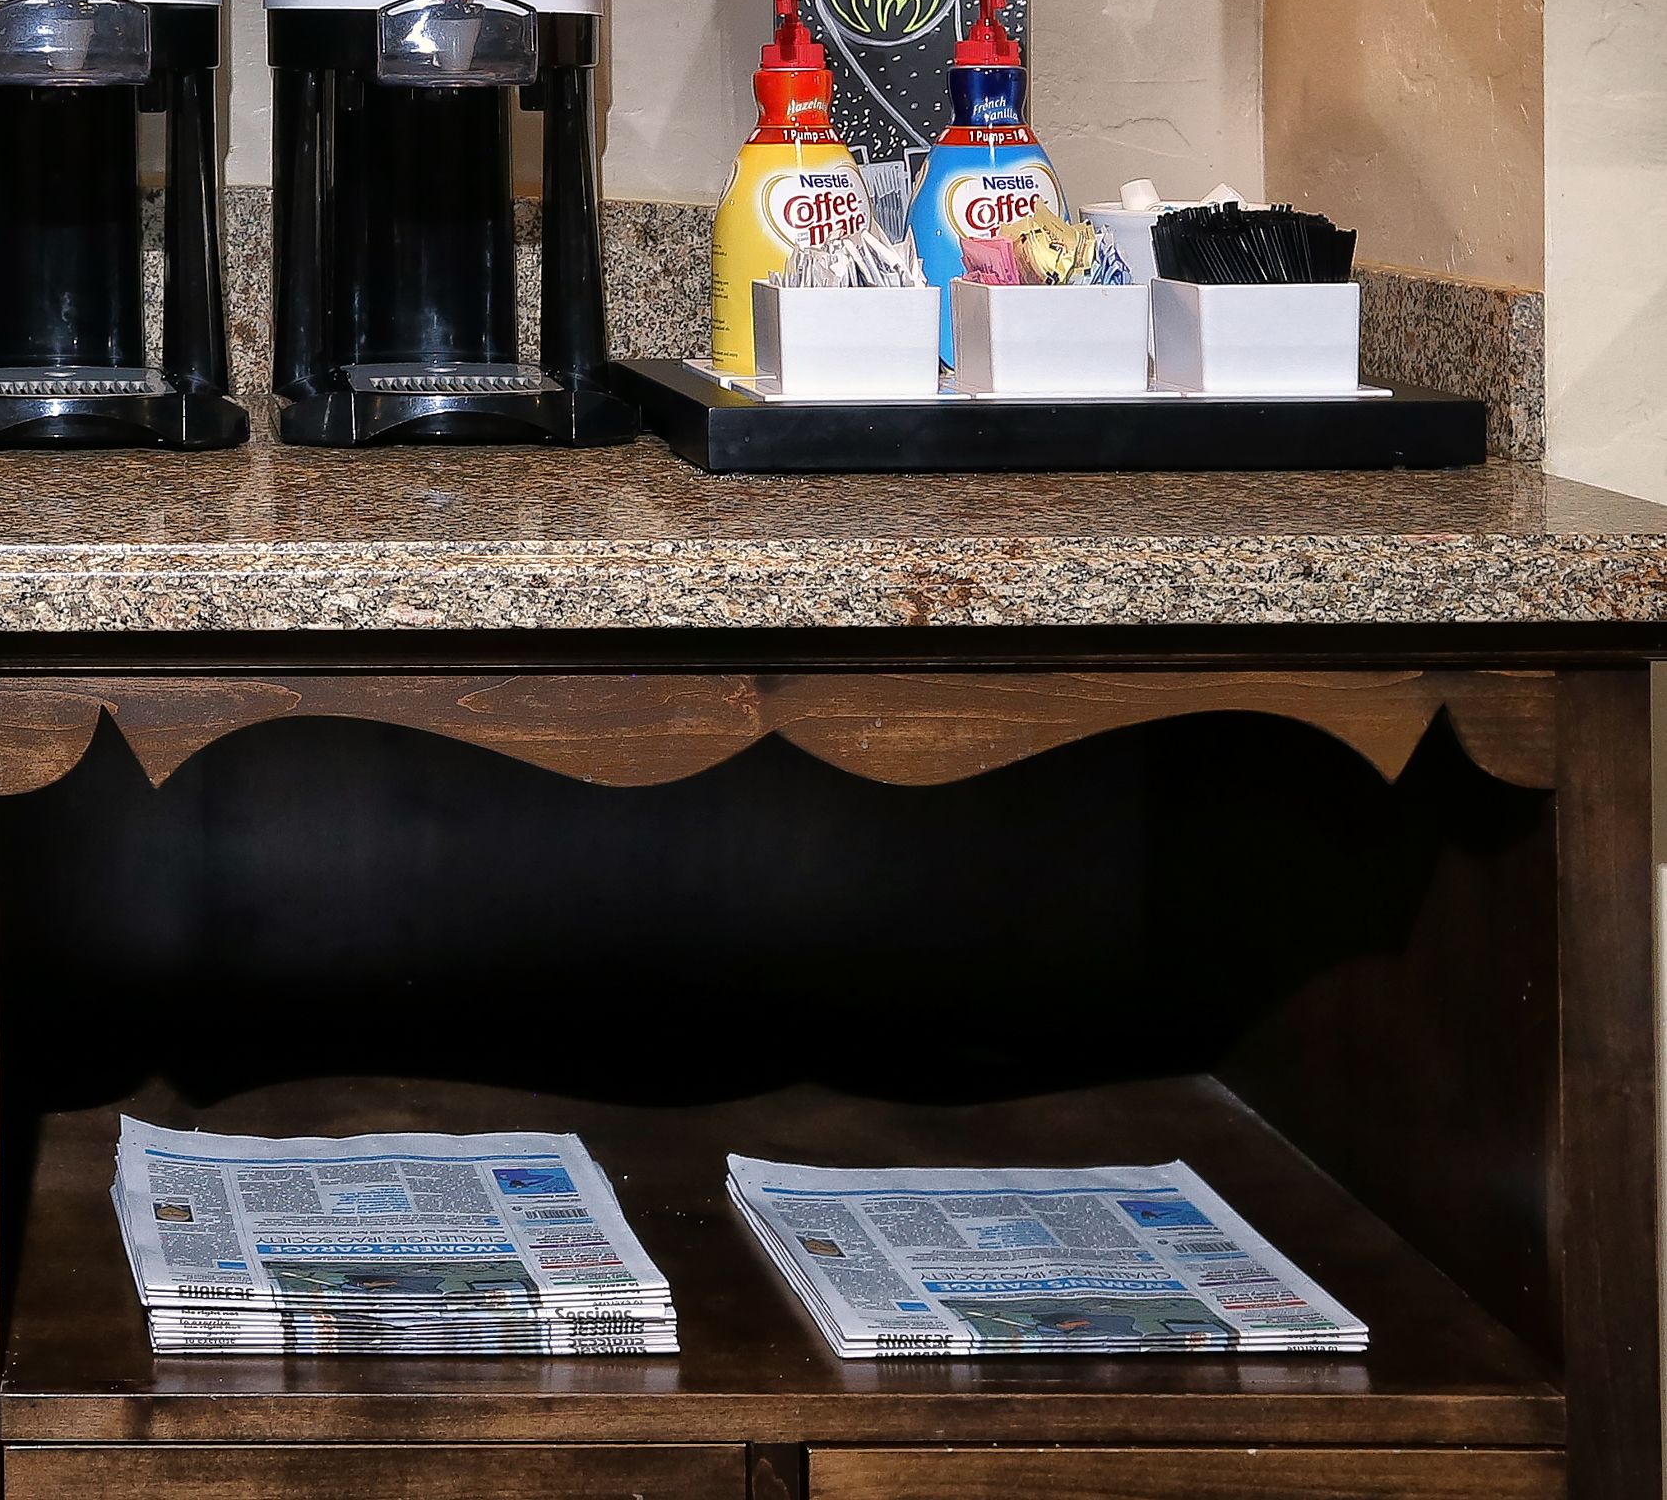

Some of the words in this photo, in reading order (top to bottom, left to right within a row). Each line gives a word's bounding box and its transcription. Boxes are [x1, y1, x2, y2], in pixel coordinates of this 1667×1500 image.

[808, 213, 867, 246] mate
[255, 1236, 334, 1245] SOCIETY
[269, 1245, 374, 1254] GARAGE
[379, 1244, 503, 1254] WOMEN'S
